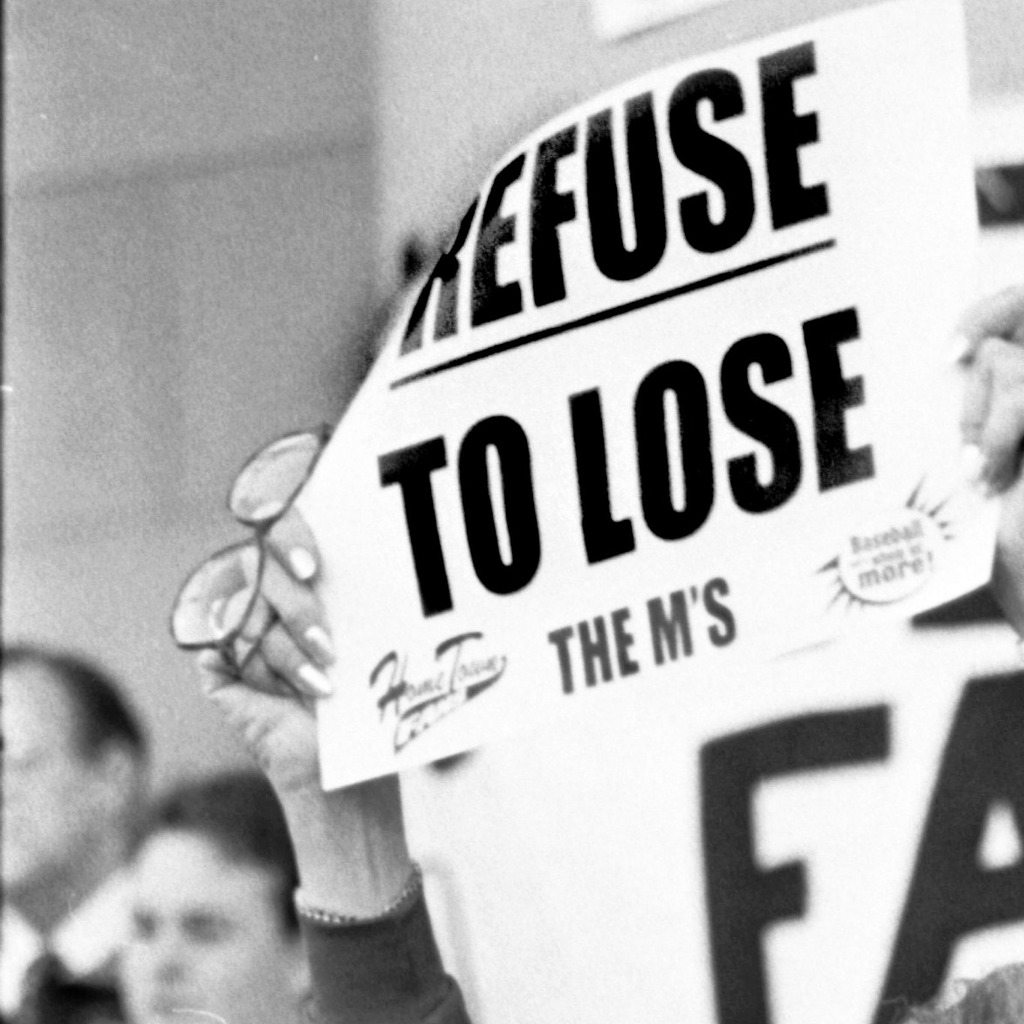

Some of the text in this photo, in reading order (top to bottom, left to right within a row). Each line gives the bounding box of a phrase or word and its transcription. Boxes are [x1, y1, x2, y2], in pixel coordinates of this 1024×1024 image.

[377, 415, 542, 618] TO
[568, 306, 876, 567] LOSE
[850, 518, 925, 555] Baseball
[547, 576, 738, 695] THE M'S
